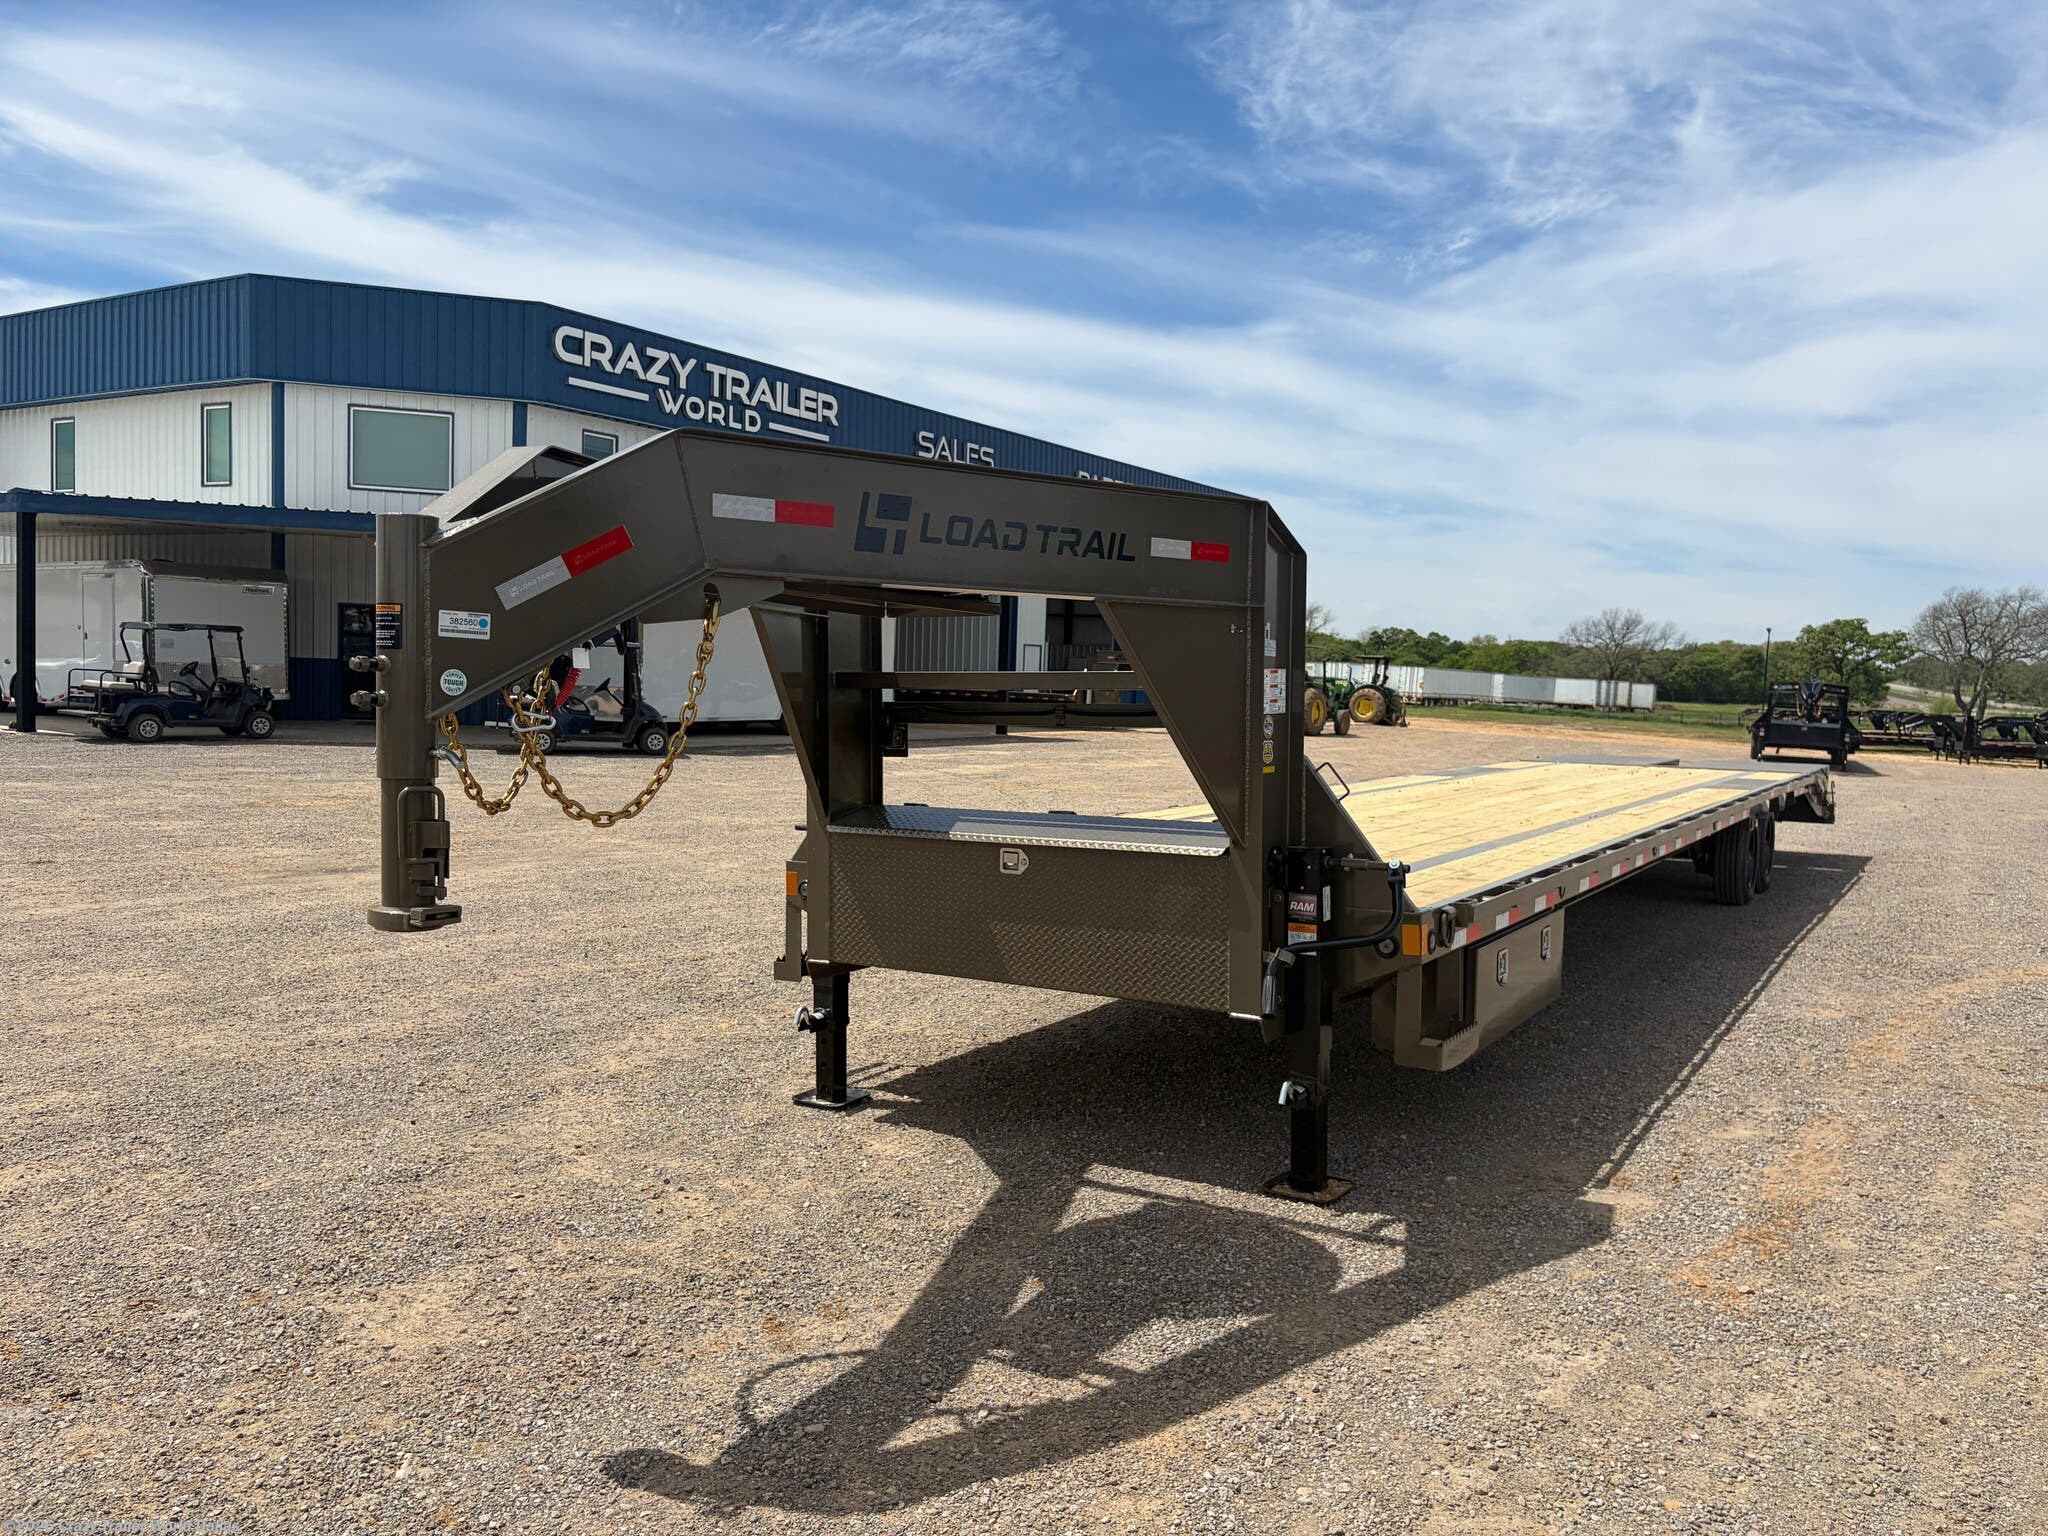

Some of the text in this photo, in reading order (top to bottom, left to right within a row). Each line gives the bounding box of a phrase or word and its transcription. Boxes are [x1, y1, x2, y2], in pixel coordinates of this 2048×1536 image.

[554, 325, 839, 427] CRAZY TRAILER
[658, 388, 762, 433] WORLD
[917, 430, 995, 468] SALES
[920, 512, 1136, 563] LOAD TRAIL
[448, 616, 478, 627] 382560
[444, 679, 464, 687] TOUGH
[1290, 901, 1315, 912] RAM
